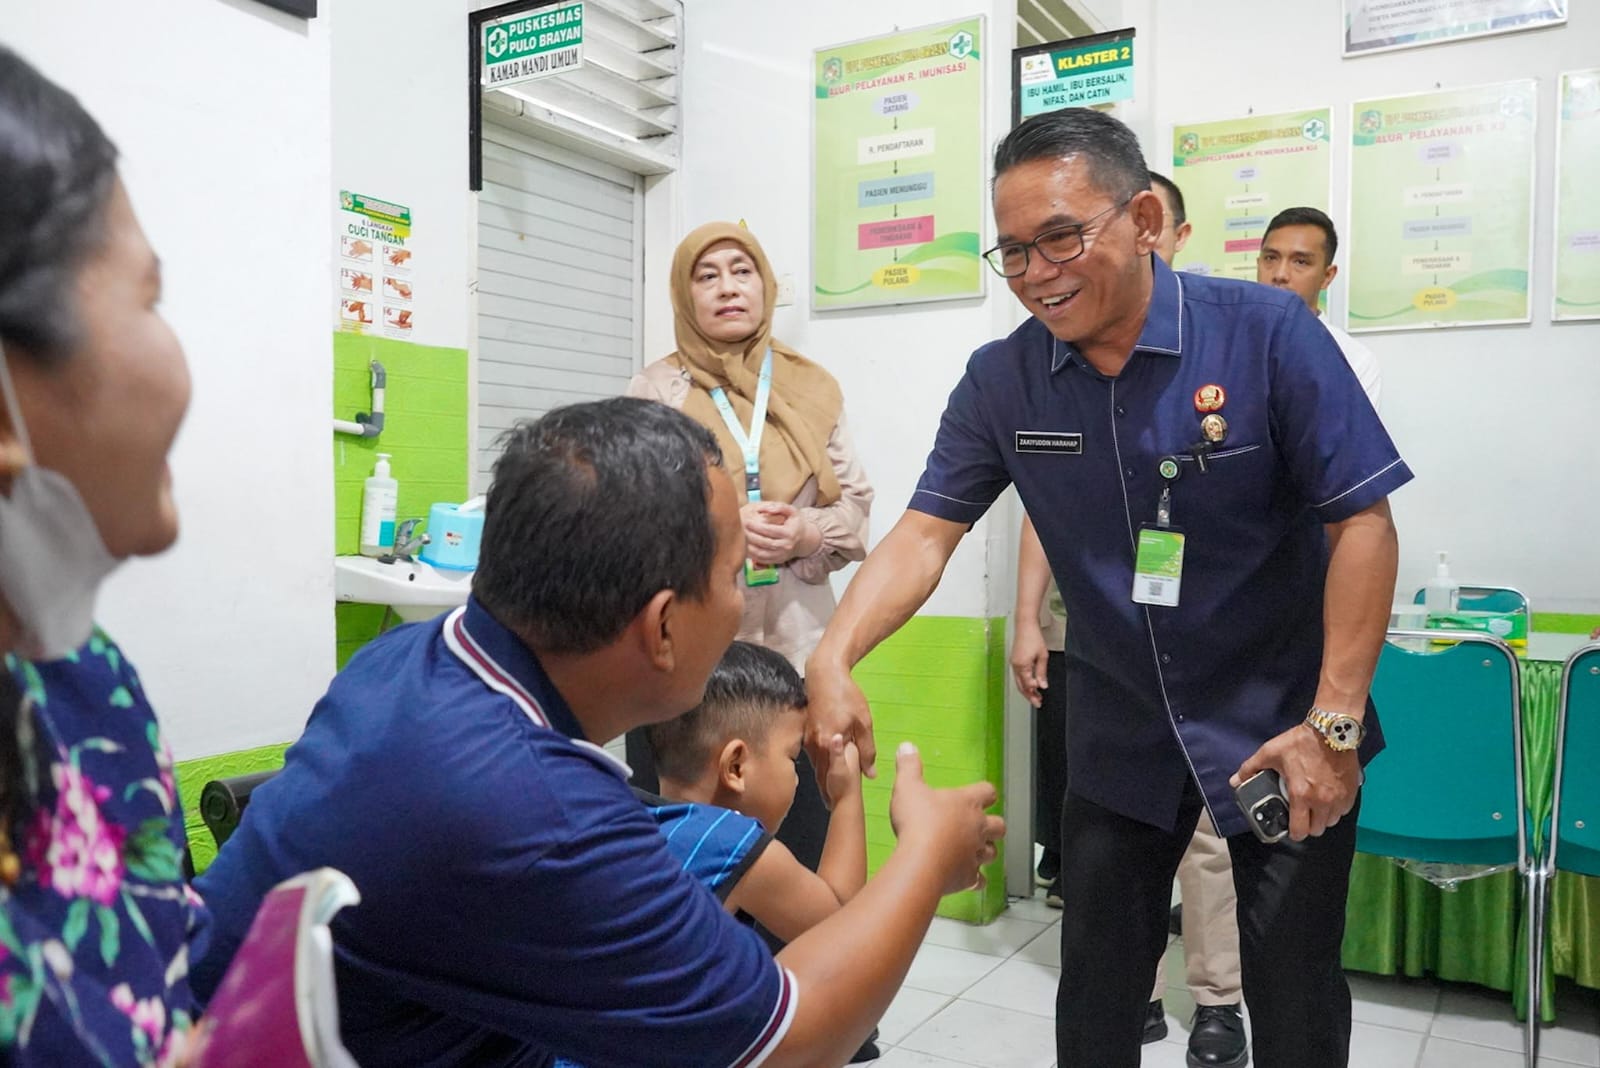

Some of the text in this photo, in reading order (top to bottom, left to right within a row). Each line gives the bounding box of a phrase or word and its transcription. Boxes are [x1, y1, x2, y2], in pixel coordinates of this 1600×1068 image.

[509, 7, 582, 37] PUSKESMAS
[509, 26, 581, 54] PULO BRAYAN
[490, 48, 578, 83] KAMAR MANDI UMUM
[1058, 46, 1130, 70] KLASTER 2
[829, 84, 851, 96] ALUR
[855, 74, 906, 91] PELAYANAN
[919, 62, 967, 78] IMUNISASI
[1027, 88, 1040, 97] IBU
[1042, 82, 1068, 95] HAMIL,
[1070, 80, 1084, 90] IBU
[1042, 88, 1111, 106] NIFAS, DAN CATIN
[877, 138, 924, 152] PENDAFTARAN
[1376, 133, 1403, 144] ALUR
[1408, 125, 1473, 140] PELAYANAN
[865, 188, 888, 198] PASIEN
[348, 223, 405, 246] CUCI TANGAN
